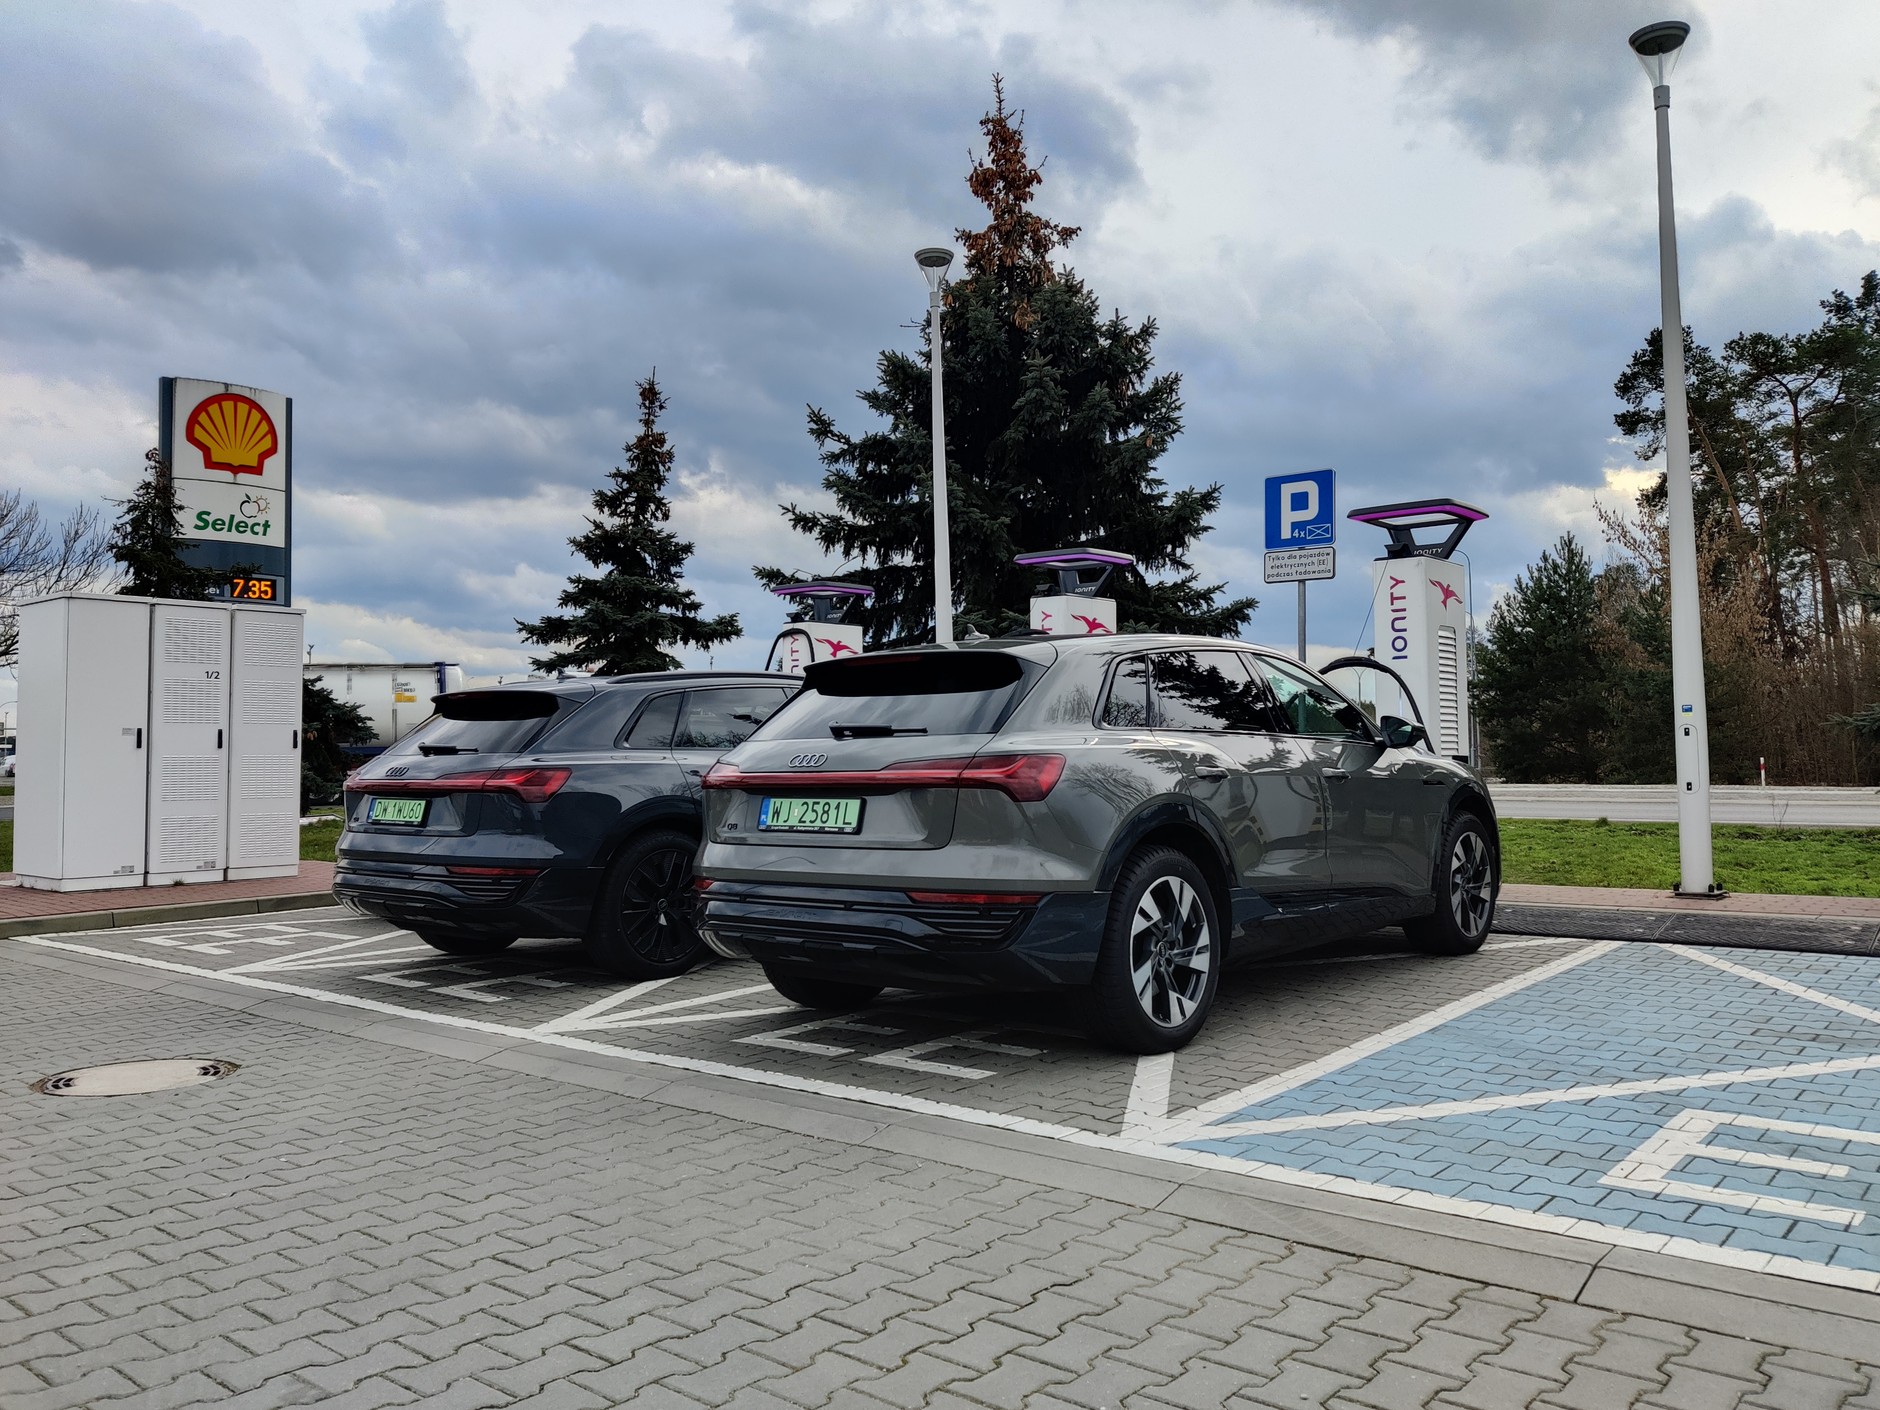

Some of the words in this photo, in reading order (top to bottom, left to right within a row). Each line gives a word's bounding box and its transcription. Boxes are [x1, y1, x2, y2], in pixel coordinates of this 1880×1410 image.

[1280, 480, 1319, 540] P
[193, 510, 271, 537] Select
[1292, 528, 1306, 539] 4x
[1268, 555, 1285, 563] Tylko
[1287, 553, 1297, 561] dla
[1298, 551, 1331, 561] pojazdów
[1270, 559, 1315, 570] elektrycznych
[1266, 570, 1294, 580] podczas
[1295, 567, 1332, 576] ładowania
[232, 579, 272, 600] 7.35
[1389, 575, 1408, 660] IONITY
[204, 671, 220, 680] 1/2
[374, 801, 389, 818] DW
[391, 802, 422, 820] 1WU60
[770, 801, 792, 824] WJ
[797, 801, 852, 826] 2581L
